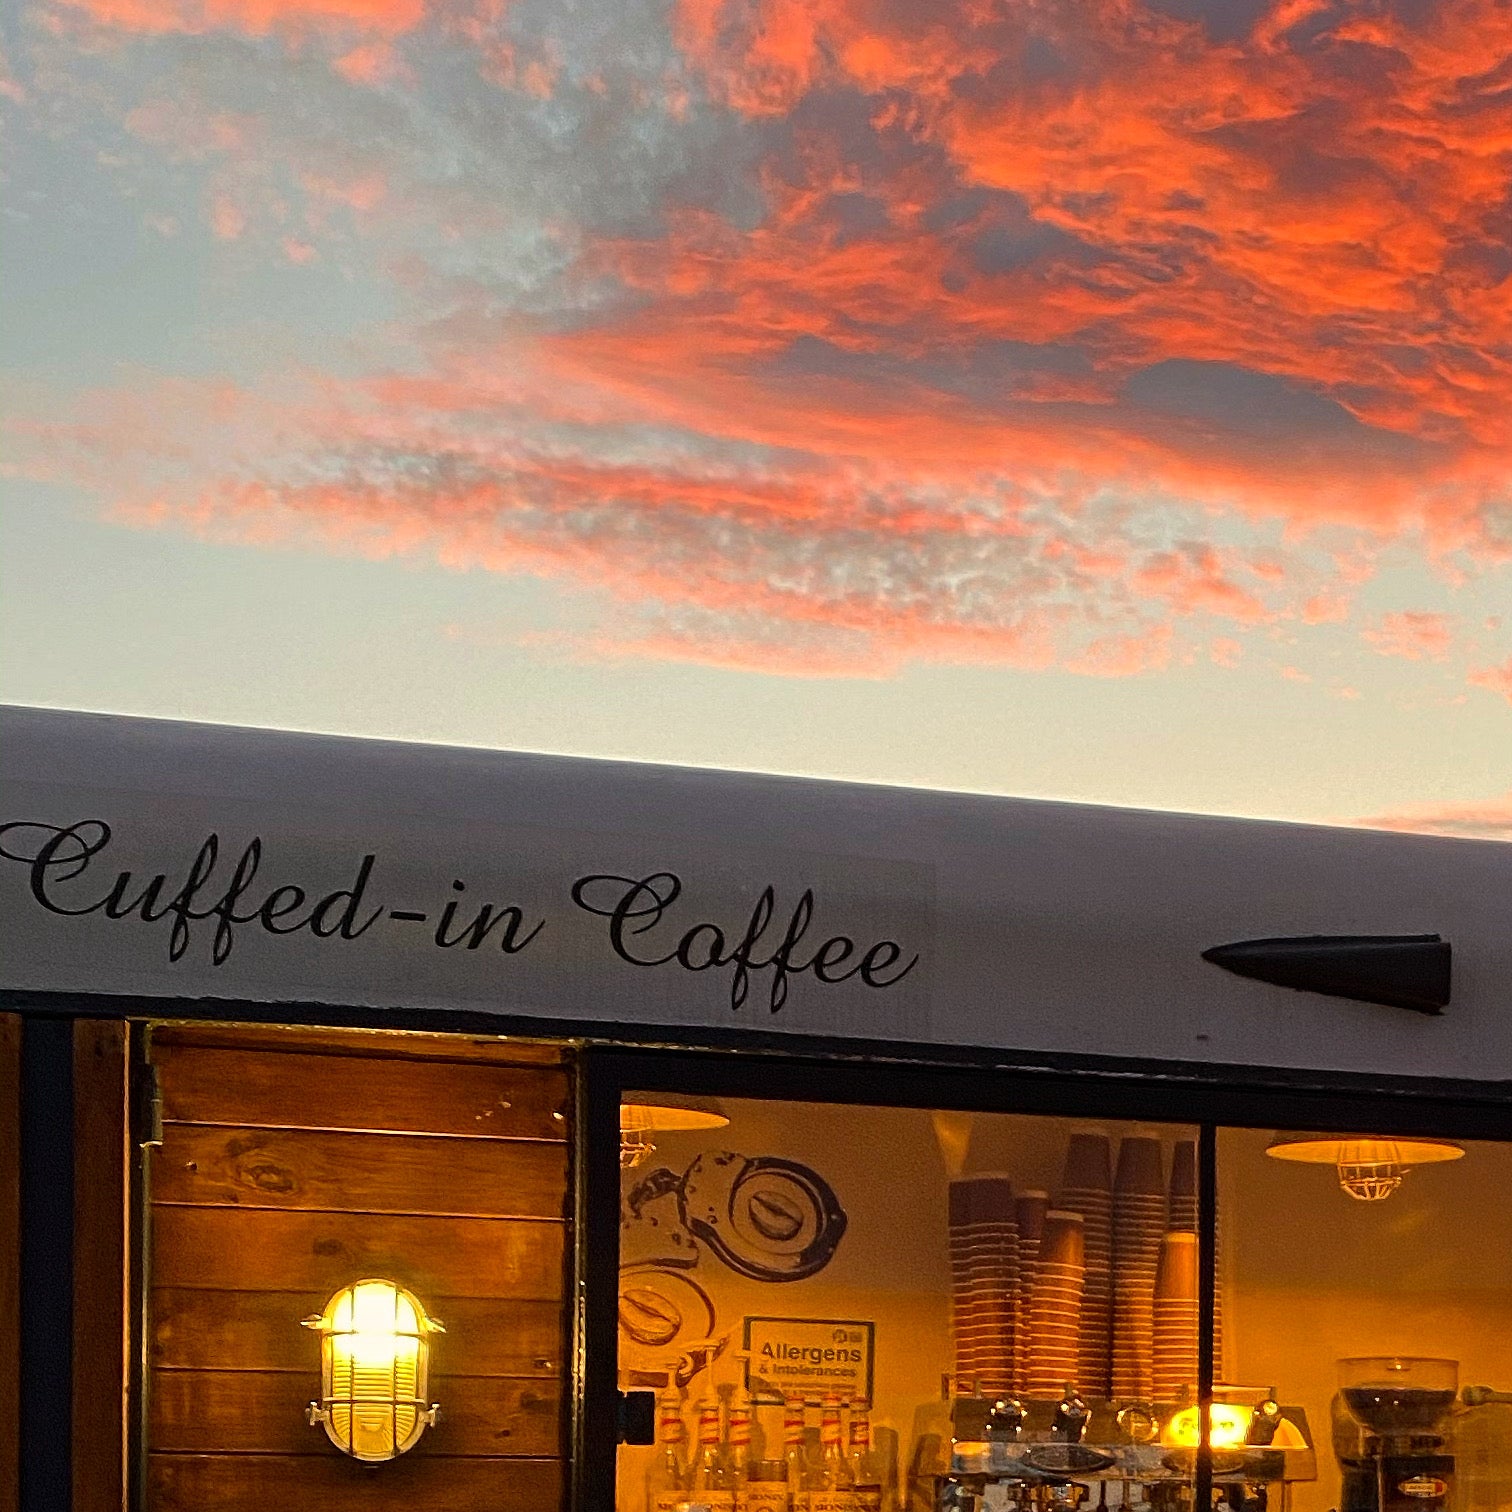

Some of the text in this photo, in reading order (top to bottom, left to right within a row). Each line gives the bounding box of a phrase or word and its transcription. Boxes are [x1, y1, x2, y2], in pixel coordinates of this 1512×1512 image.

[0, 819, 920, 1014] Cuffed-in Coffee
[762, 1342, 863, 1365] Allergens
[773, 1364, 857, 1378] Intolerances
